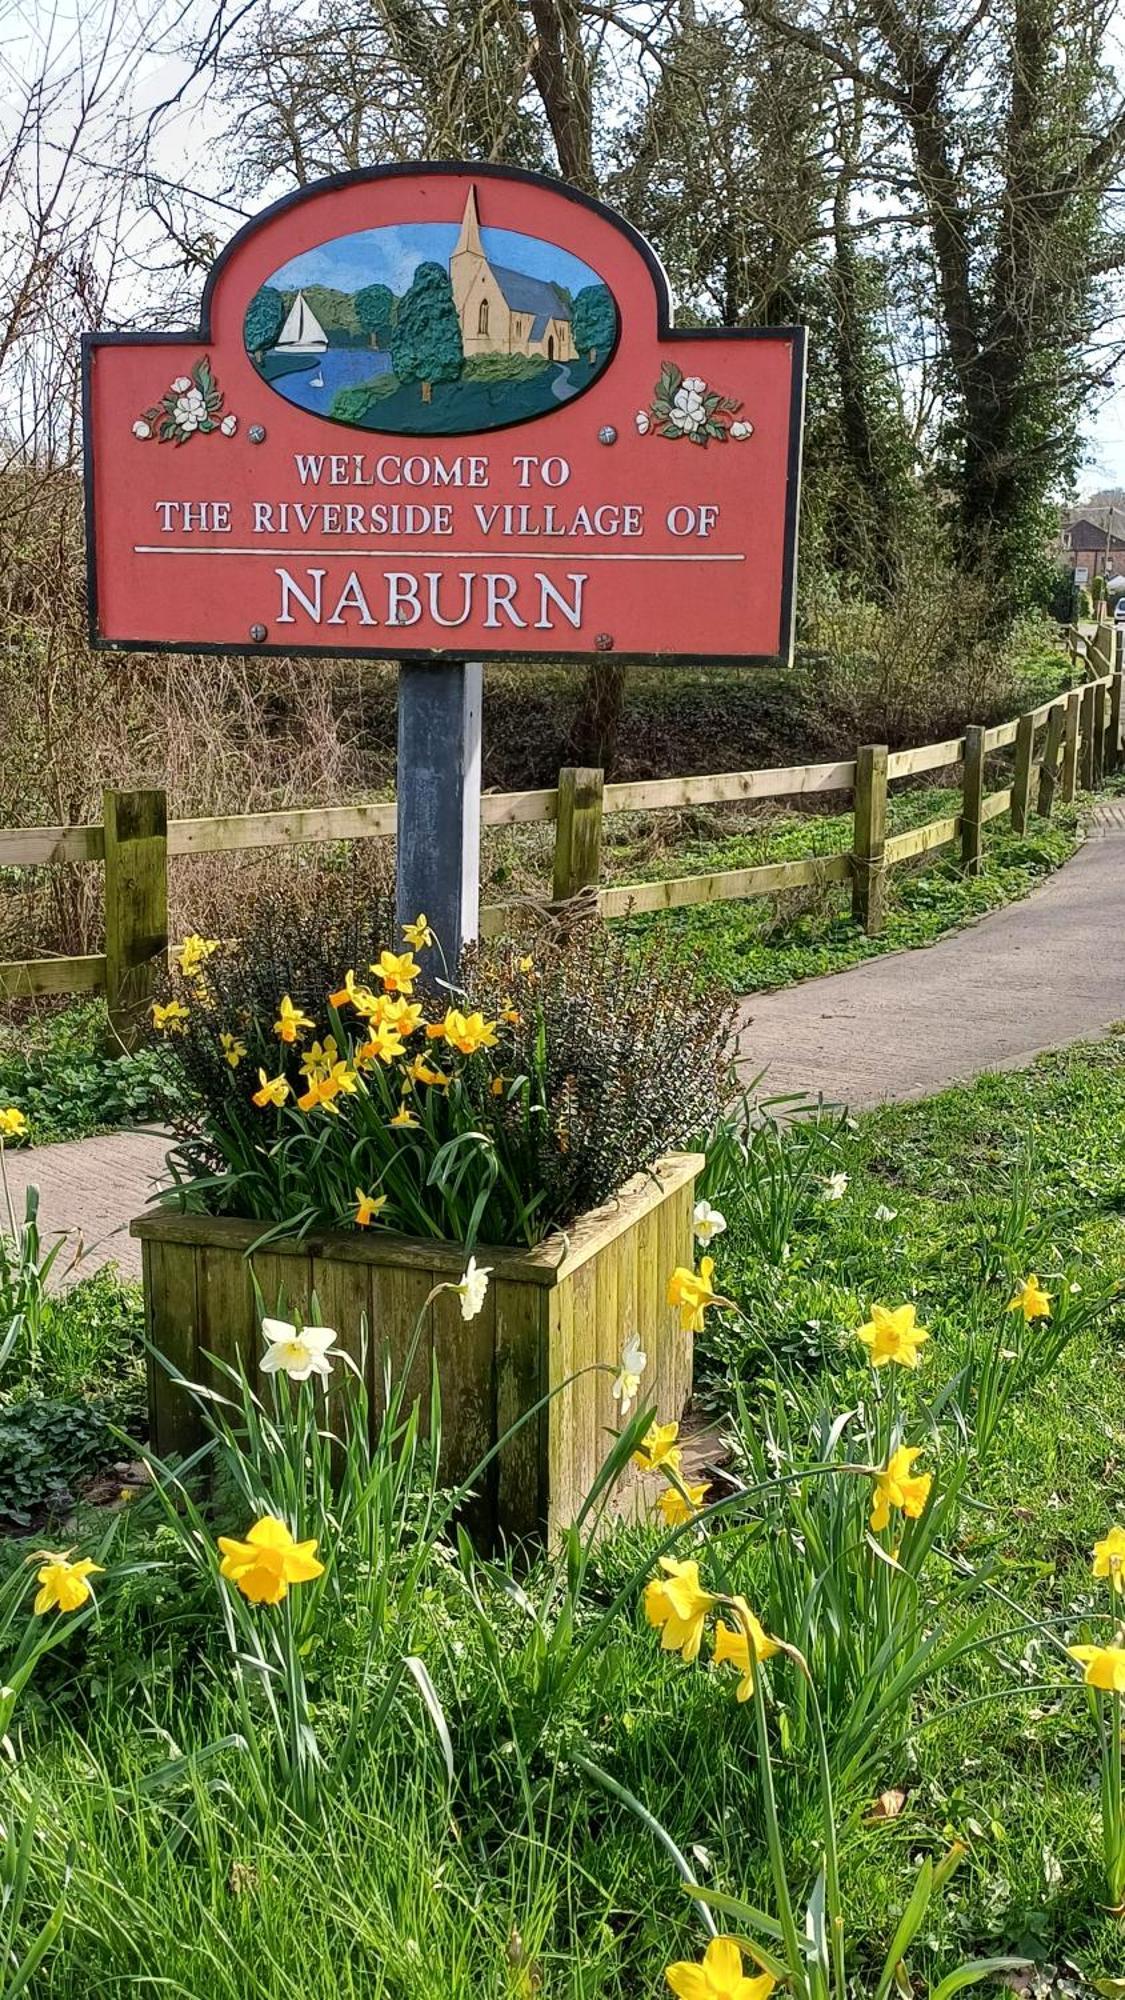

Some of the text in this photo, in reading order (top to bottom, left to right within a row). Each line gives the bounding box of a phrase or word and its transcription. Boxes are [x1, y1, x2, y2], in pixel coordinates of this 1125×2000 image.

[295, 454, 570, 488] WELCOME TO
[156, 501, 720, 537] THE RIVERSIDE VILLAGE OF
[275, 568, 588, 630] NABURN
